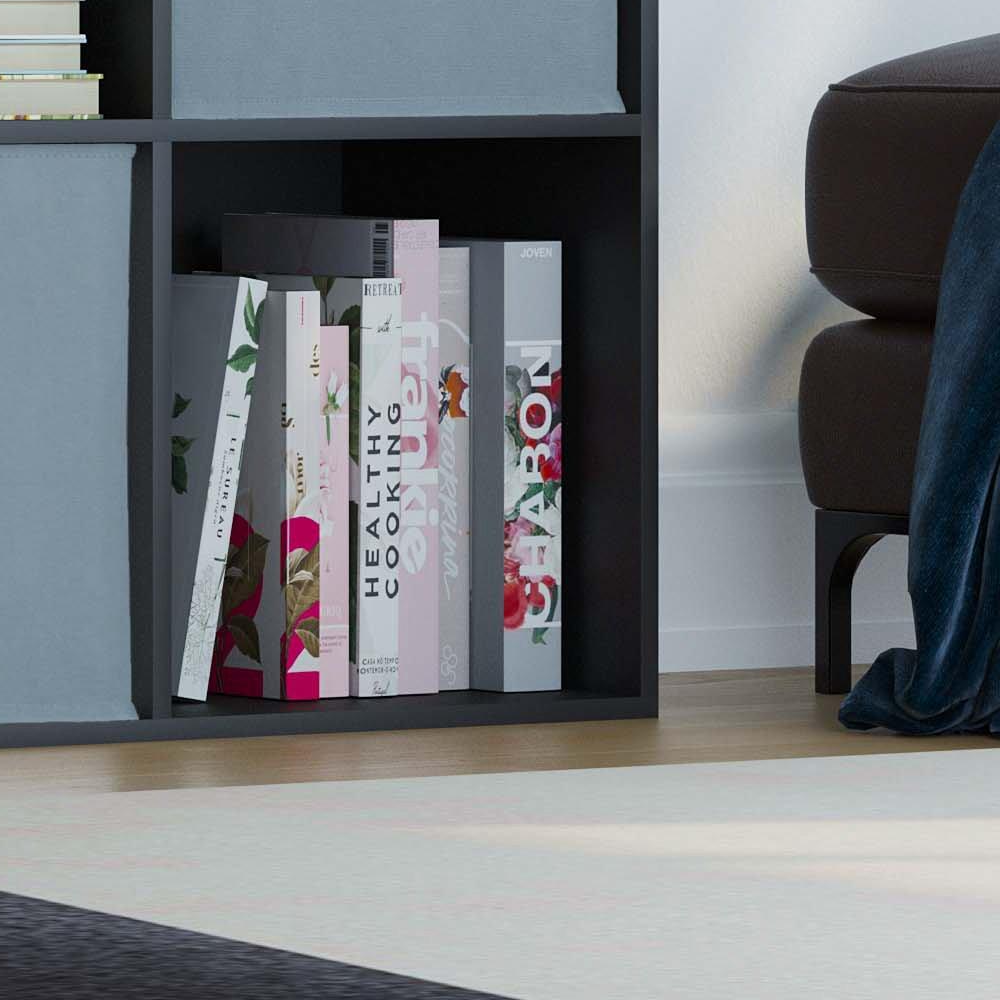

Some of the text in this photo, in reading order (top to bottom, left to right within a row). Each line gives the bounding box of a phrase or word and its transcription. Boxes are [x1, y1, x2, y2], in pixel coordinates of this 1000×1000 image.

[519, 247, 553, 259] JOVEN
[216, 466, 233, 539] SUREAU
[364, 404, 381, 598] HEALTHY
[385, 402, 401, 600] COOKING
[400, 312, 440, 575] frankie
[519, 346, 552, 624] CHABON
